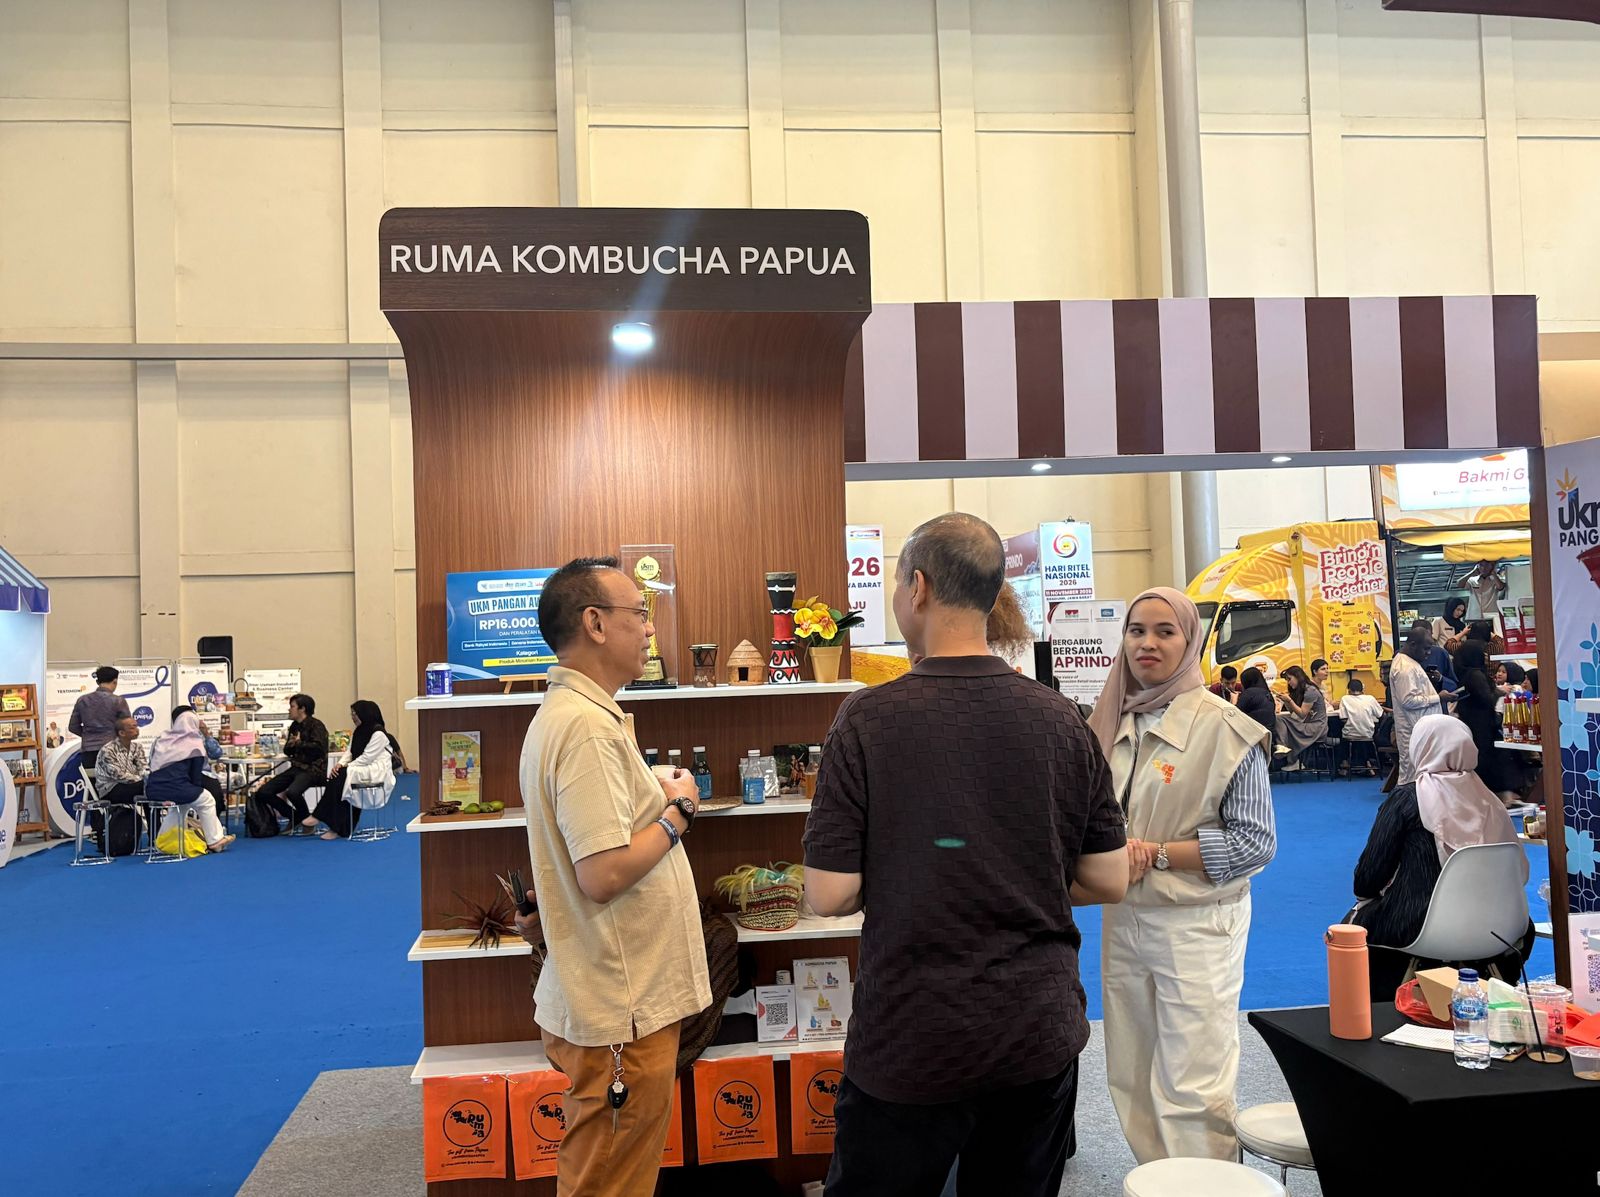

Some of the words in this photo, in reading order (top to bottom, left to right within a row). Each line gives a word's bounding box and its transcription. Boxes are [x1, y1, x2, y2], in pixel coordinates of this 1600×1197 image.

[390, 244, 502, 273] RUMA
[512, 244, 731, 274] KOMBUCHA
[740, 246, 857, 275] PAPUA
[1458, 468, 1510, 484] Bakmi
[1560, 529, 1599, 547] PANG
[1005, 552, 1023, 570] PRINDO
[1068, 564, 1091, 572] RITEL
[1045, 571, 1091, 580] NASIONAL
[1321, 559, 1384, 585] People
[1322, 577, 1385, 600] Together
[470, 600, 490, 613] UKM
[492, 597, 527, 611] PANGAN
[480, 617, 540, 630] RP16.000.
[1052, 638, 1103, 646] BERGABUNG
[1053, 647, 1103, 655] BERSAMA
[1054, 656, 1116, 668] APRIND
